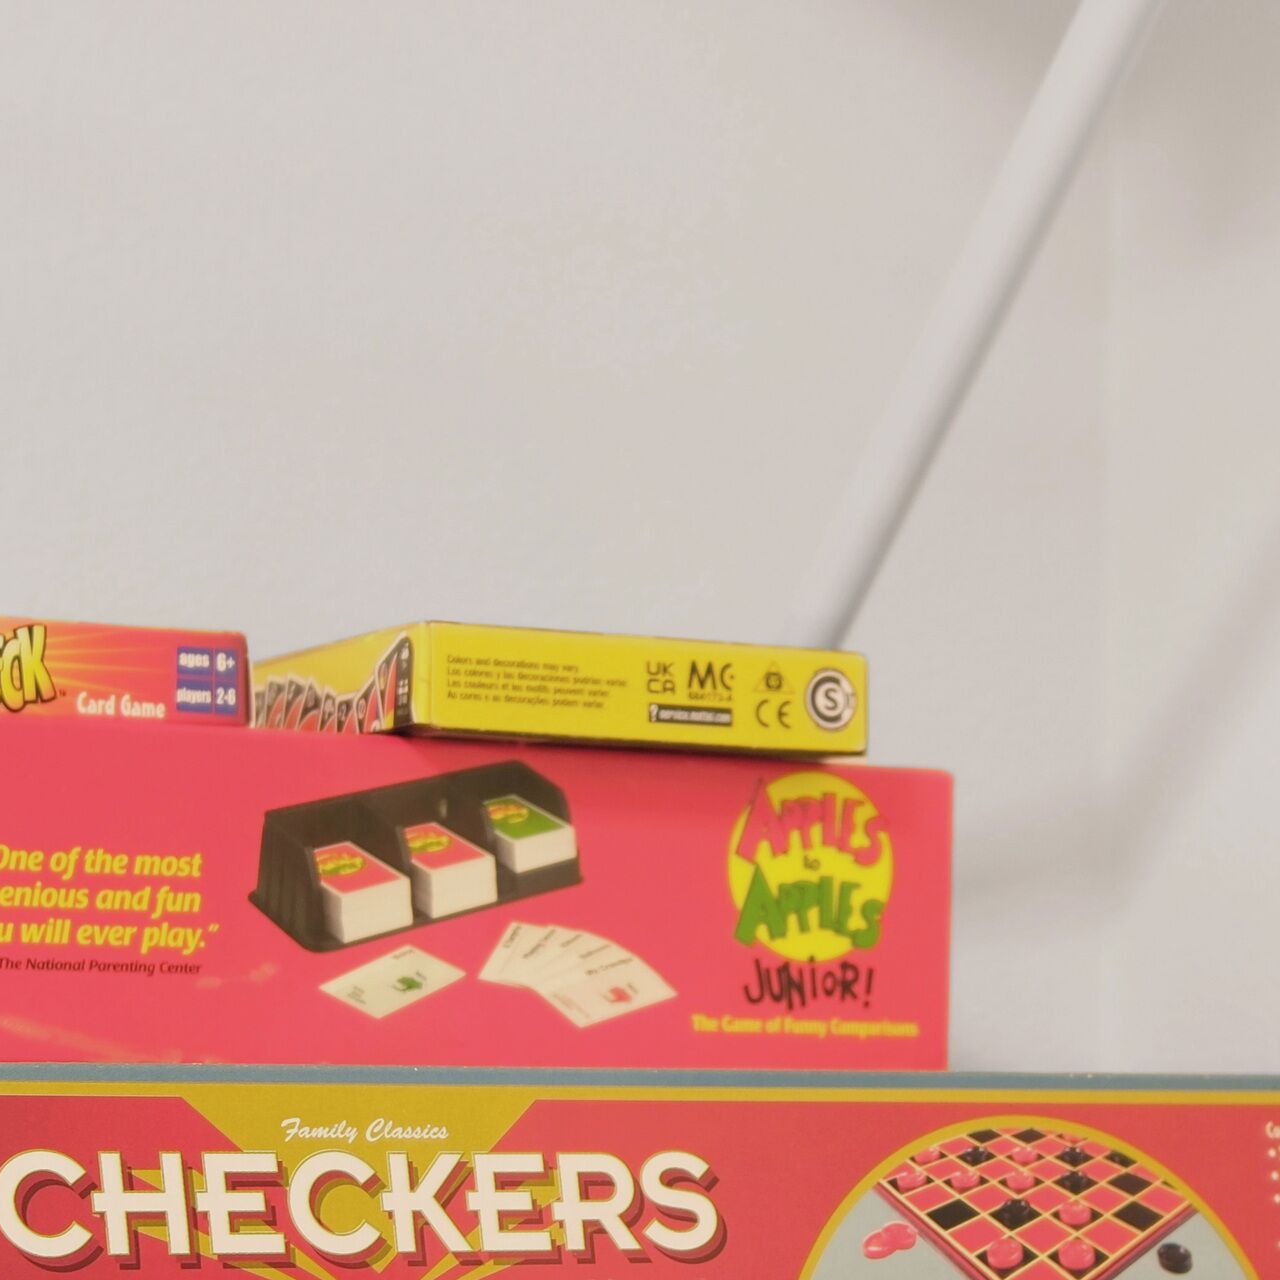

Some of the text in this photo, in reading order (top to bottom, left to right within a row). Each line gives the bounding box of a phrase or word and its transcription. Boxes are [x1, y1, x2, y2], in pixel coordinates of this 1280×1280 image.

[179, 652, 236, 672] ages 6+
[646, 661, 674, 677] UK
[177, 688, 212, 704] players
[646, 678, 676, 695] CA
[76, 691, 166, 718] Card Game
[755, 699, 792, 729] CE
[50, 846, 81, 881] of
[84, 848, 128, 875] the
[133, 852, 202, 878] most
[96, 886, 151, 913] and
[152, 887, 202, 919] fun
[734, 864, 886, 948] APPLES
[20, 919, 71, 944] will
[76, 924, 136, 947] ever
[25, 957, 86, 973] National
[89, 959, 156, 977] Parenting
[159, 960, 203, 975] Center
[280, 1117, 450, 1144] Family Classics
